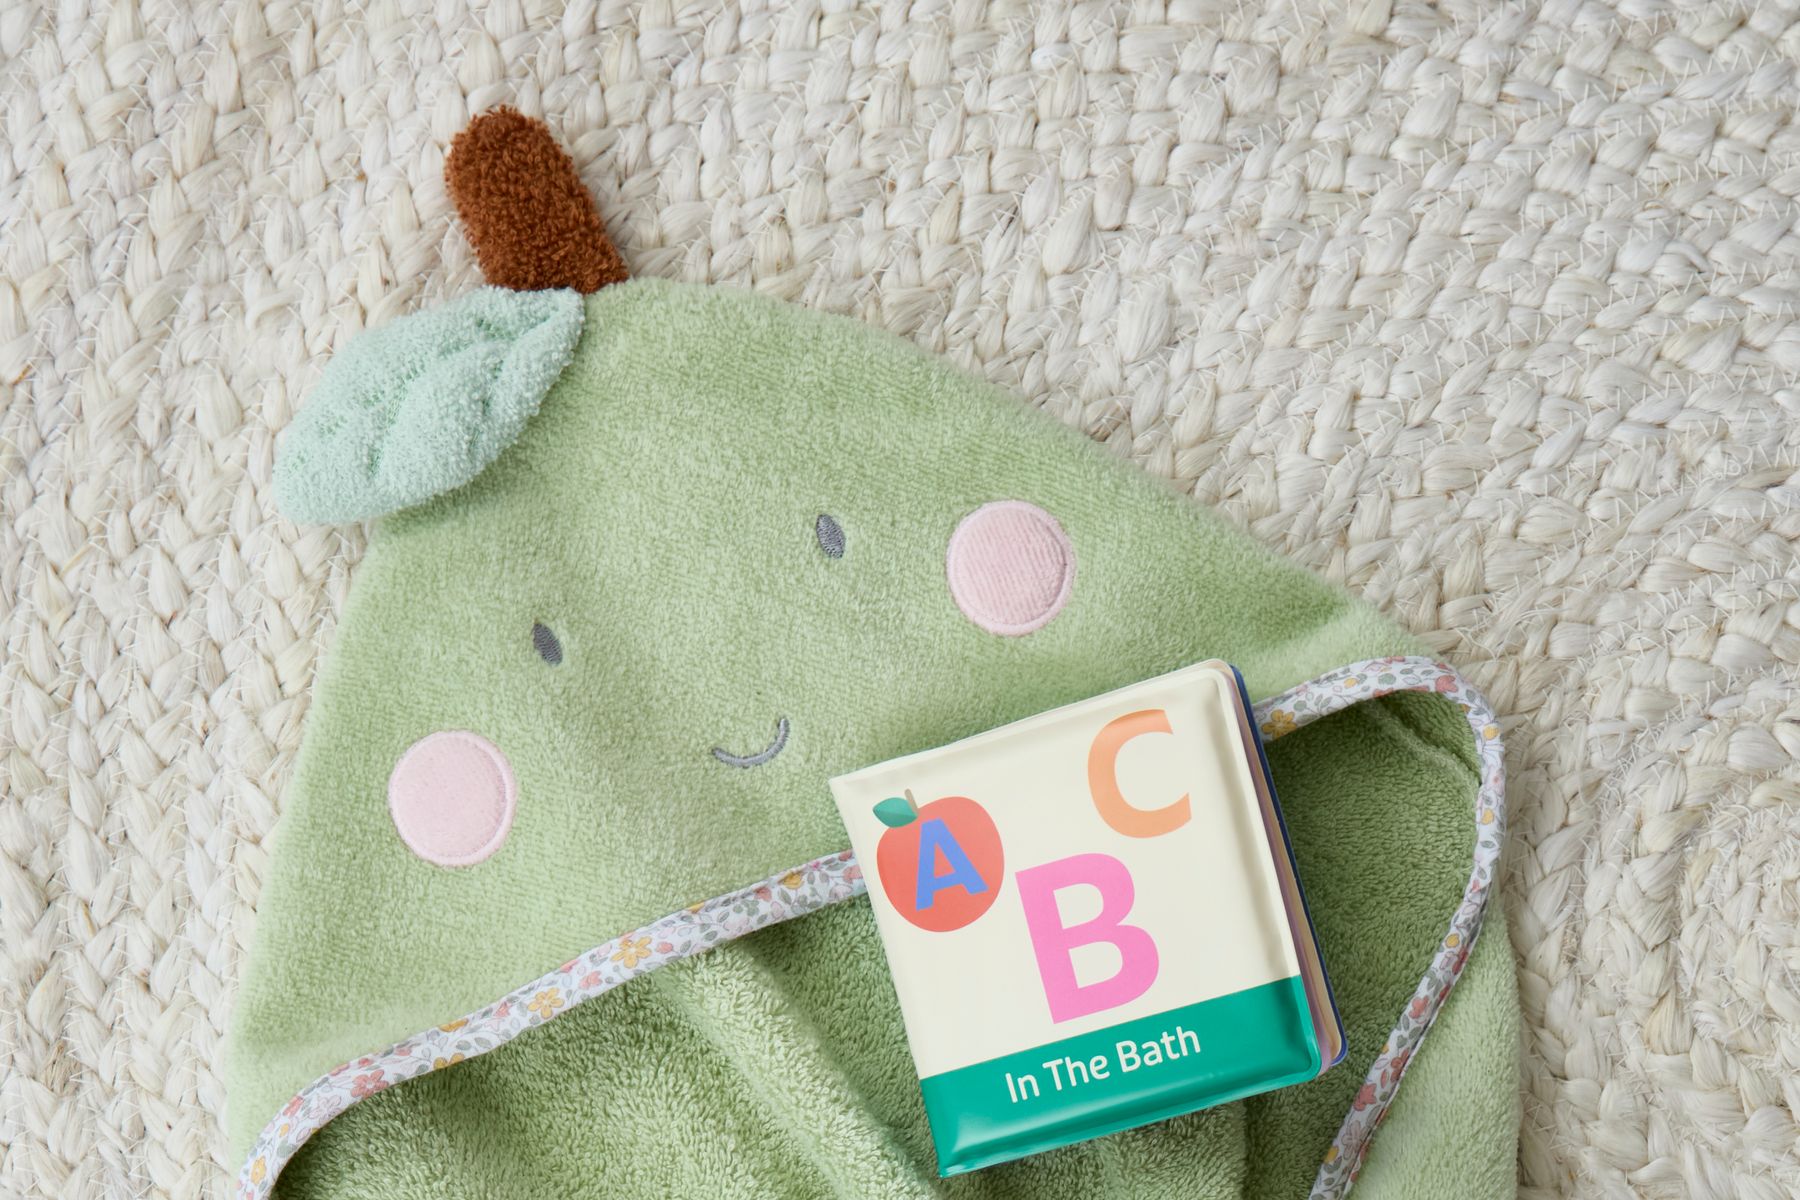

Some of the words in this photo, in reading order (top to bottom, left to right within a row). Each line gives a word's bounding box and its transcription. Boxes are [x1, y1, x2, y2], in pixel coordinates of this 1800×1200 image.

[1088, 709, 1192, 838] C
[916, 818, 989, 911] A
[1015, 853, 1160, 1024] B
[1005, 1072, 1040, 1104] In
[1043, 1054, 1110, 1091] The
[1116, 1027, 1201, 1073] Bath
